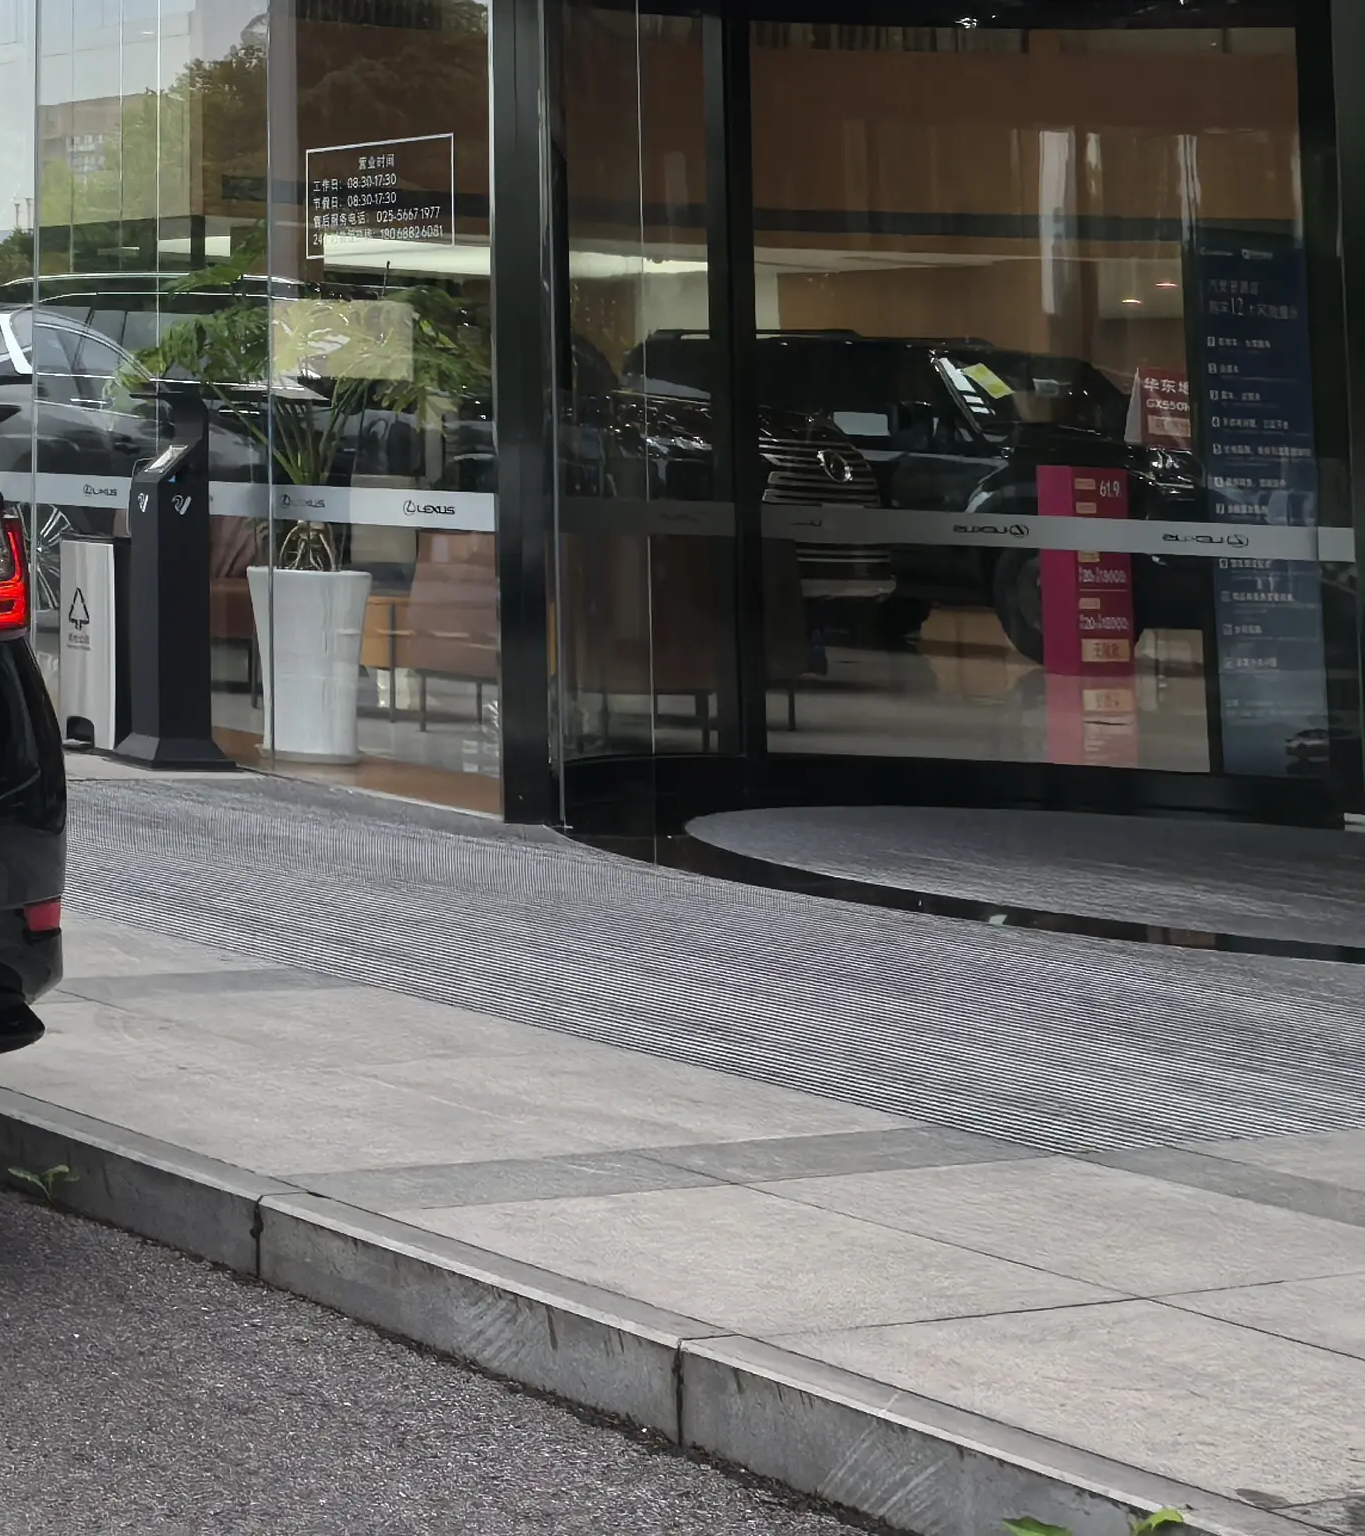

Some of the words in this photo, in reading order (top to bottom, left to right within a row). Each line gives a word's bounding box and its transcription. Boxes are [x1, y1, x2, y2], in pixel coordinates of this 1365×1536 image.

[358, 153, 395, 171] 营业时间
[417, 504, 455, 515] LEXUS
